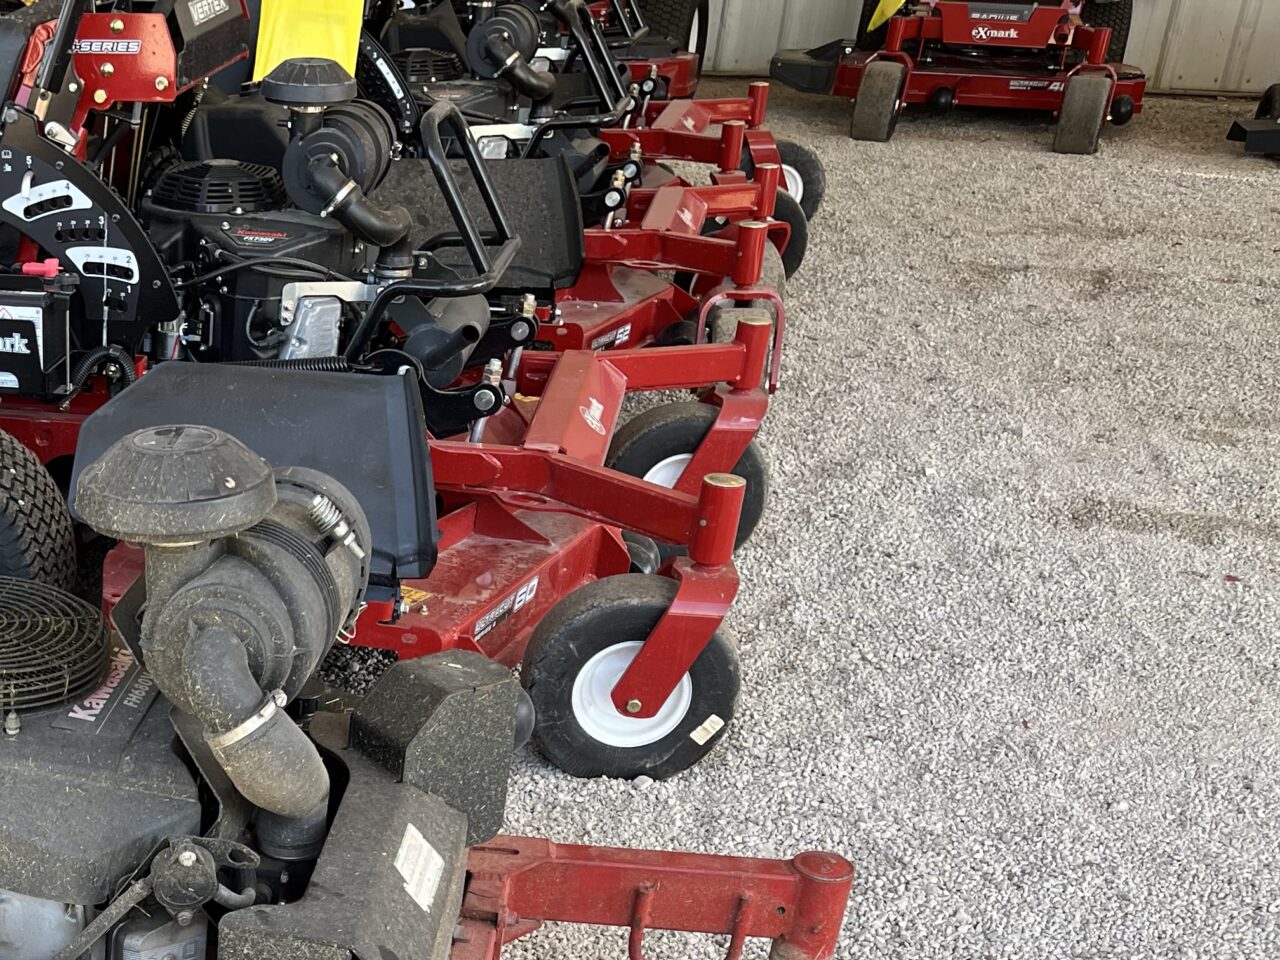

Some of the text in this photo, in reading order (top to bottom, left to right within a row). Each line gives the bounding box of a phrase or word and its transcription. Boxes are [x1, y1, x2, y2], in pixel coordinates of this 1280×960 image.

[26, 156, 32, 164] 5
[98, 216, 105, 225] 3
[126, 256, 132, 264] 2
[513, 576, 539, 613] 60
[68, 646, 134, 722] Kawasaki
